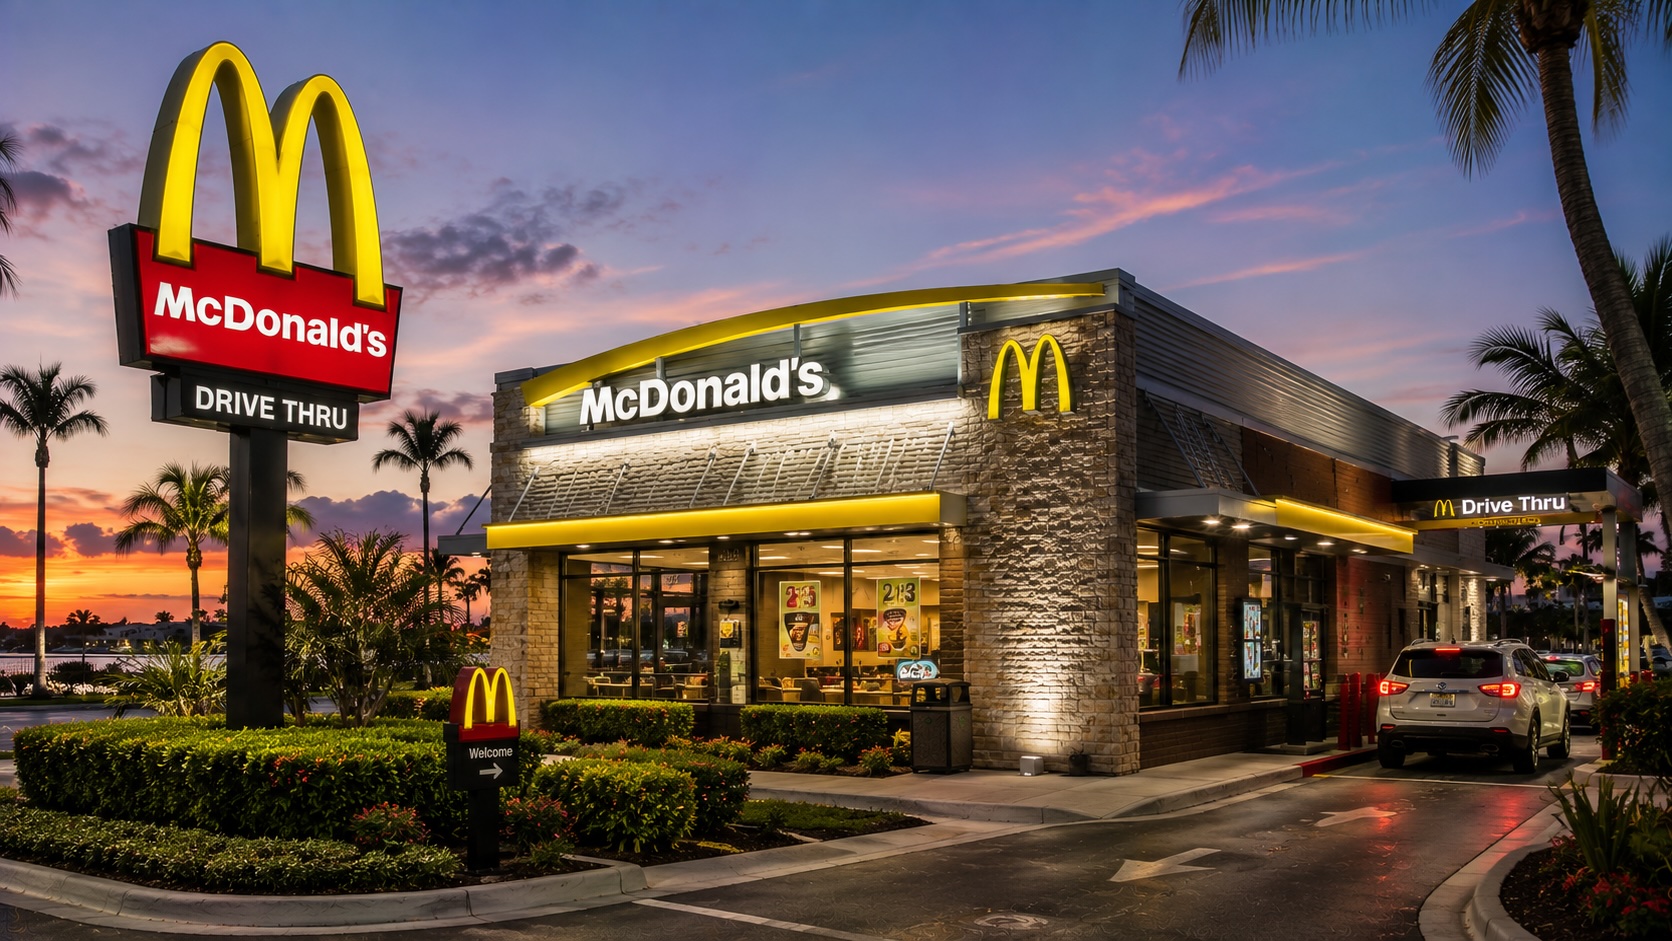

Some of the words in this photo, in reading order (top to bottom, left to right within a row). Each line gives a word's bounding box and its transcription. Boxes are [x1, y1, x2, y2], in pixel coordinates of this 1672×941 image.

[153, 281, 388, 358] McDonald's
[195, 384, 276, 421] DRIVE
[281, 397, 348, 431] THRU
[579, 356, 826, 426] McDonald's
[1461, 498, 1514, 515] Drive
[1517, 495, 1566, 512] Thru
[468, 746, 514, 760] Welcome
